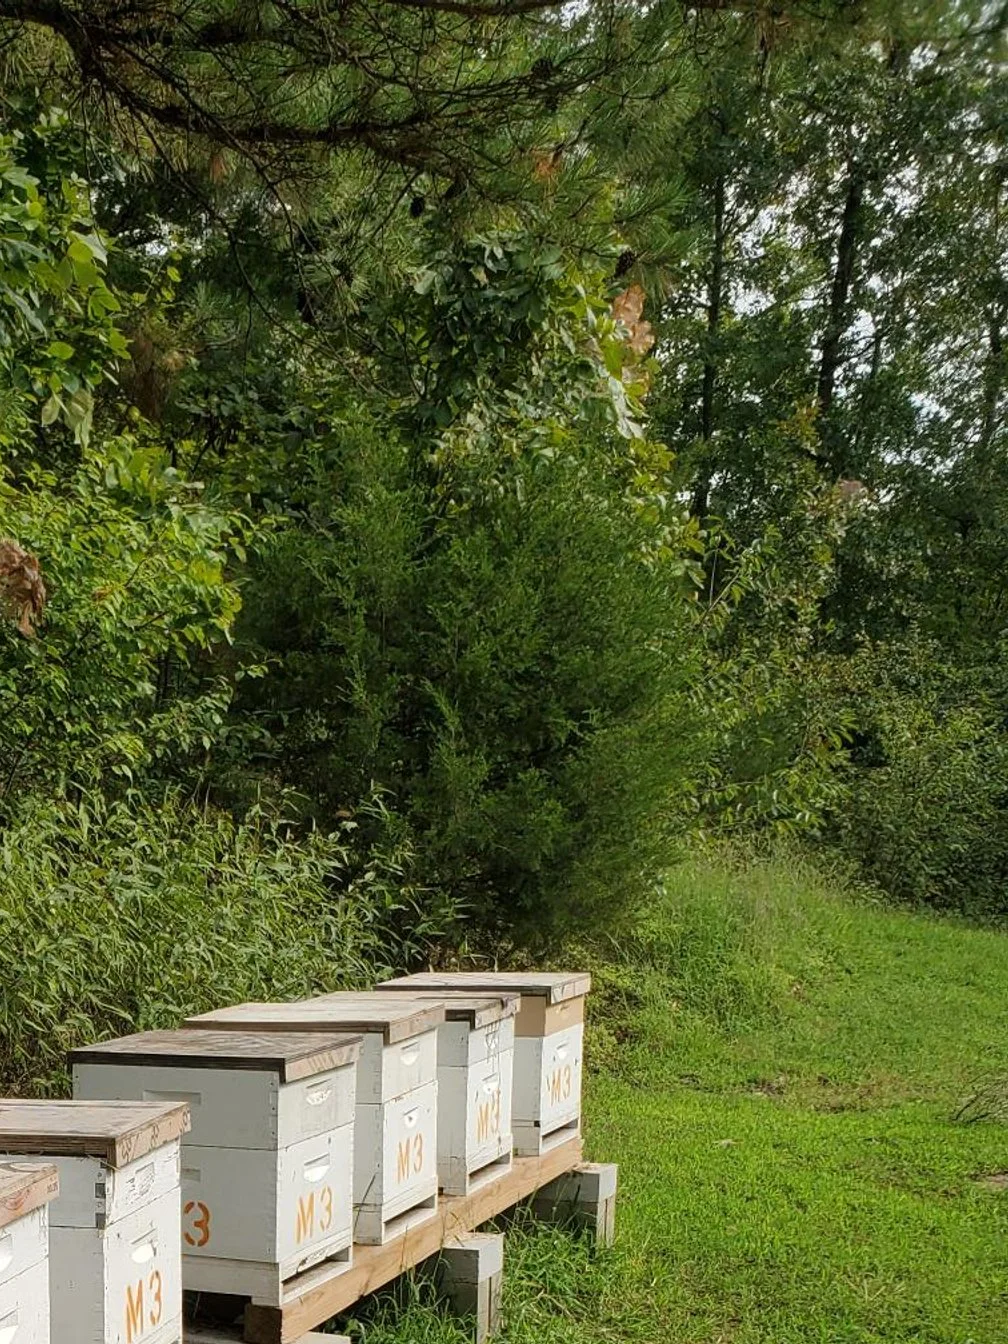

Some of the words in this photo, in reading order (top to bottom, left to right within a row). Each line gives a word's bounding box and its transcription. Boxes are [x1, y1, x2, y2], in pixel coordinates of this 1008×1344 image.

[551, 1065, 572, 1107] M3
[397, 1133, 424, 1184] M3
[182, 1200, 212, 1248] 3
[296, 1186, 333, 1245] M3
